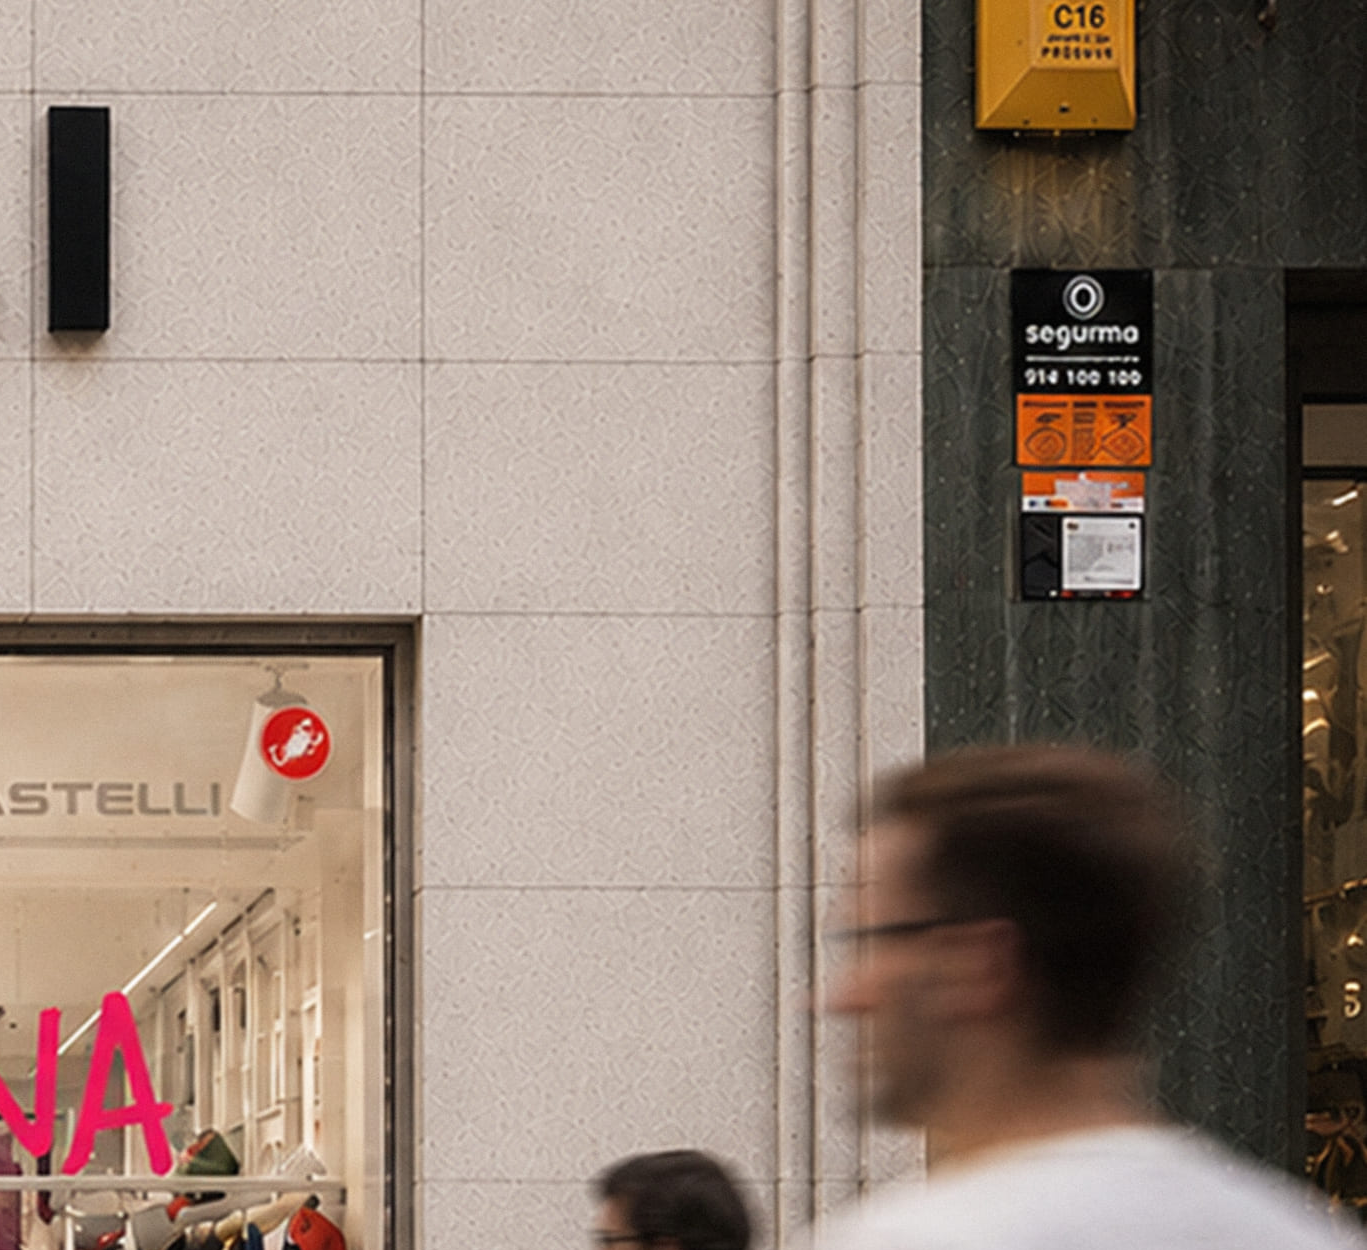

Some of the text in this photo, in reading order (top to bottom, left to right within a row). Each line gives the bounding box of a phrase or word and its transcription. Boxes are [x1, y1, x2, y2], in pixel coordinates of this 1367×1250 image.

[1054, 4, 1105, 29] C16
[1067, 369, 1101, 386] 100
[1108, 369, 1142, 386] 100
